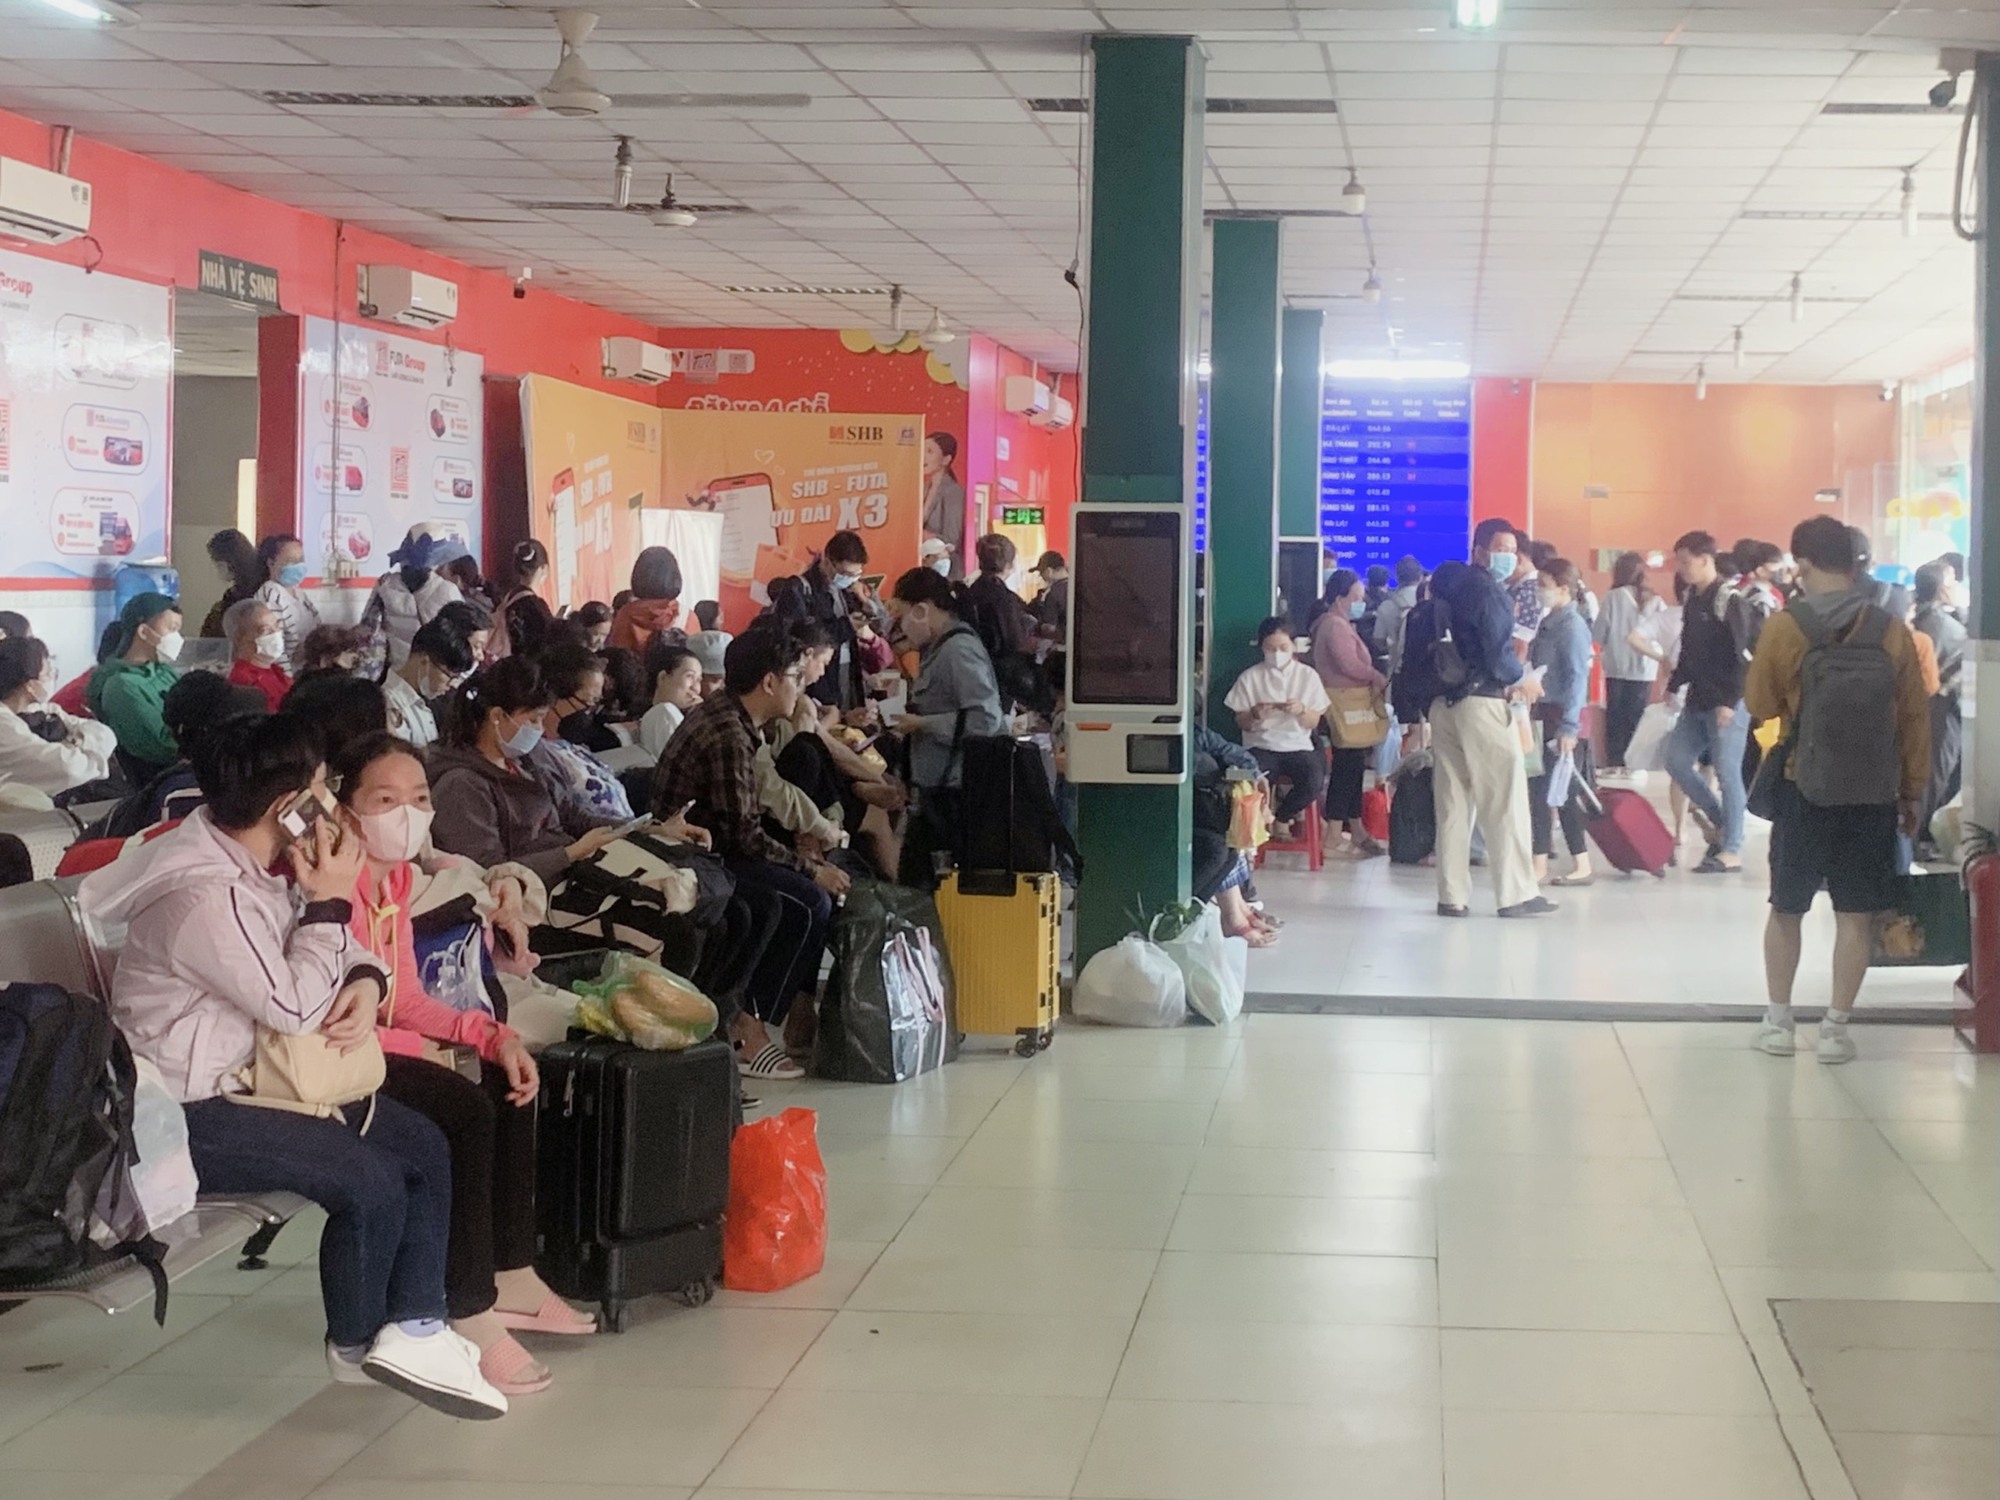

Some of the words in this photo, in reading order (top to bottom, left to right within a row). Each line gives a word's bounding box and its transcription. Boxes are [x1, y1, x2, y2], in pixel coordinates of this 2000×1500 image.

[202, 256, 227, 291] NHÀ
[229, 262, 246, 300] VỆ
[249, 272, 278, 303] SINH
[847, 426, 883, 441] SHB
[792, 480, 828, 499] SHB
[847, 472, 888, 492] FUTA
[836, 493, 889, 531] X3
